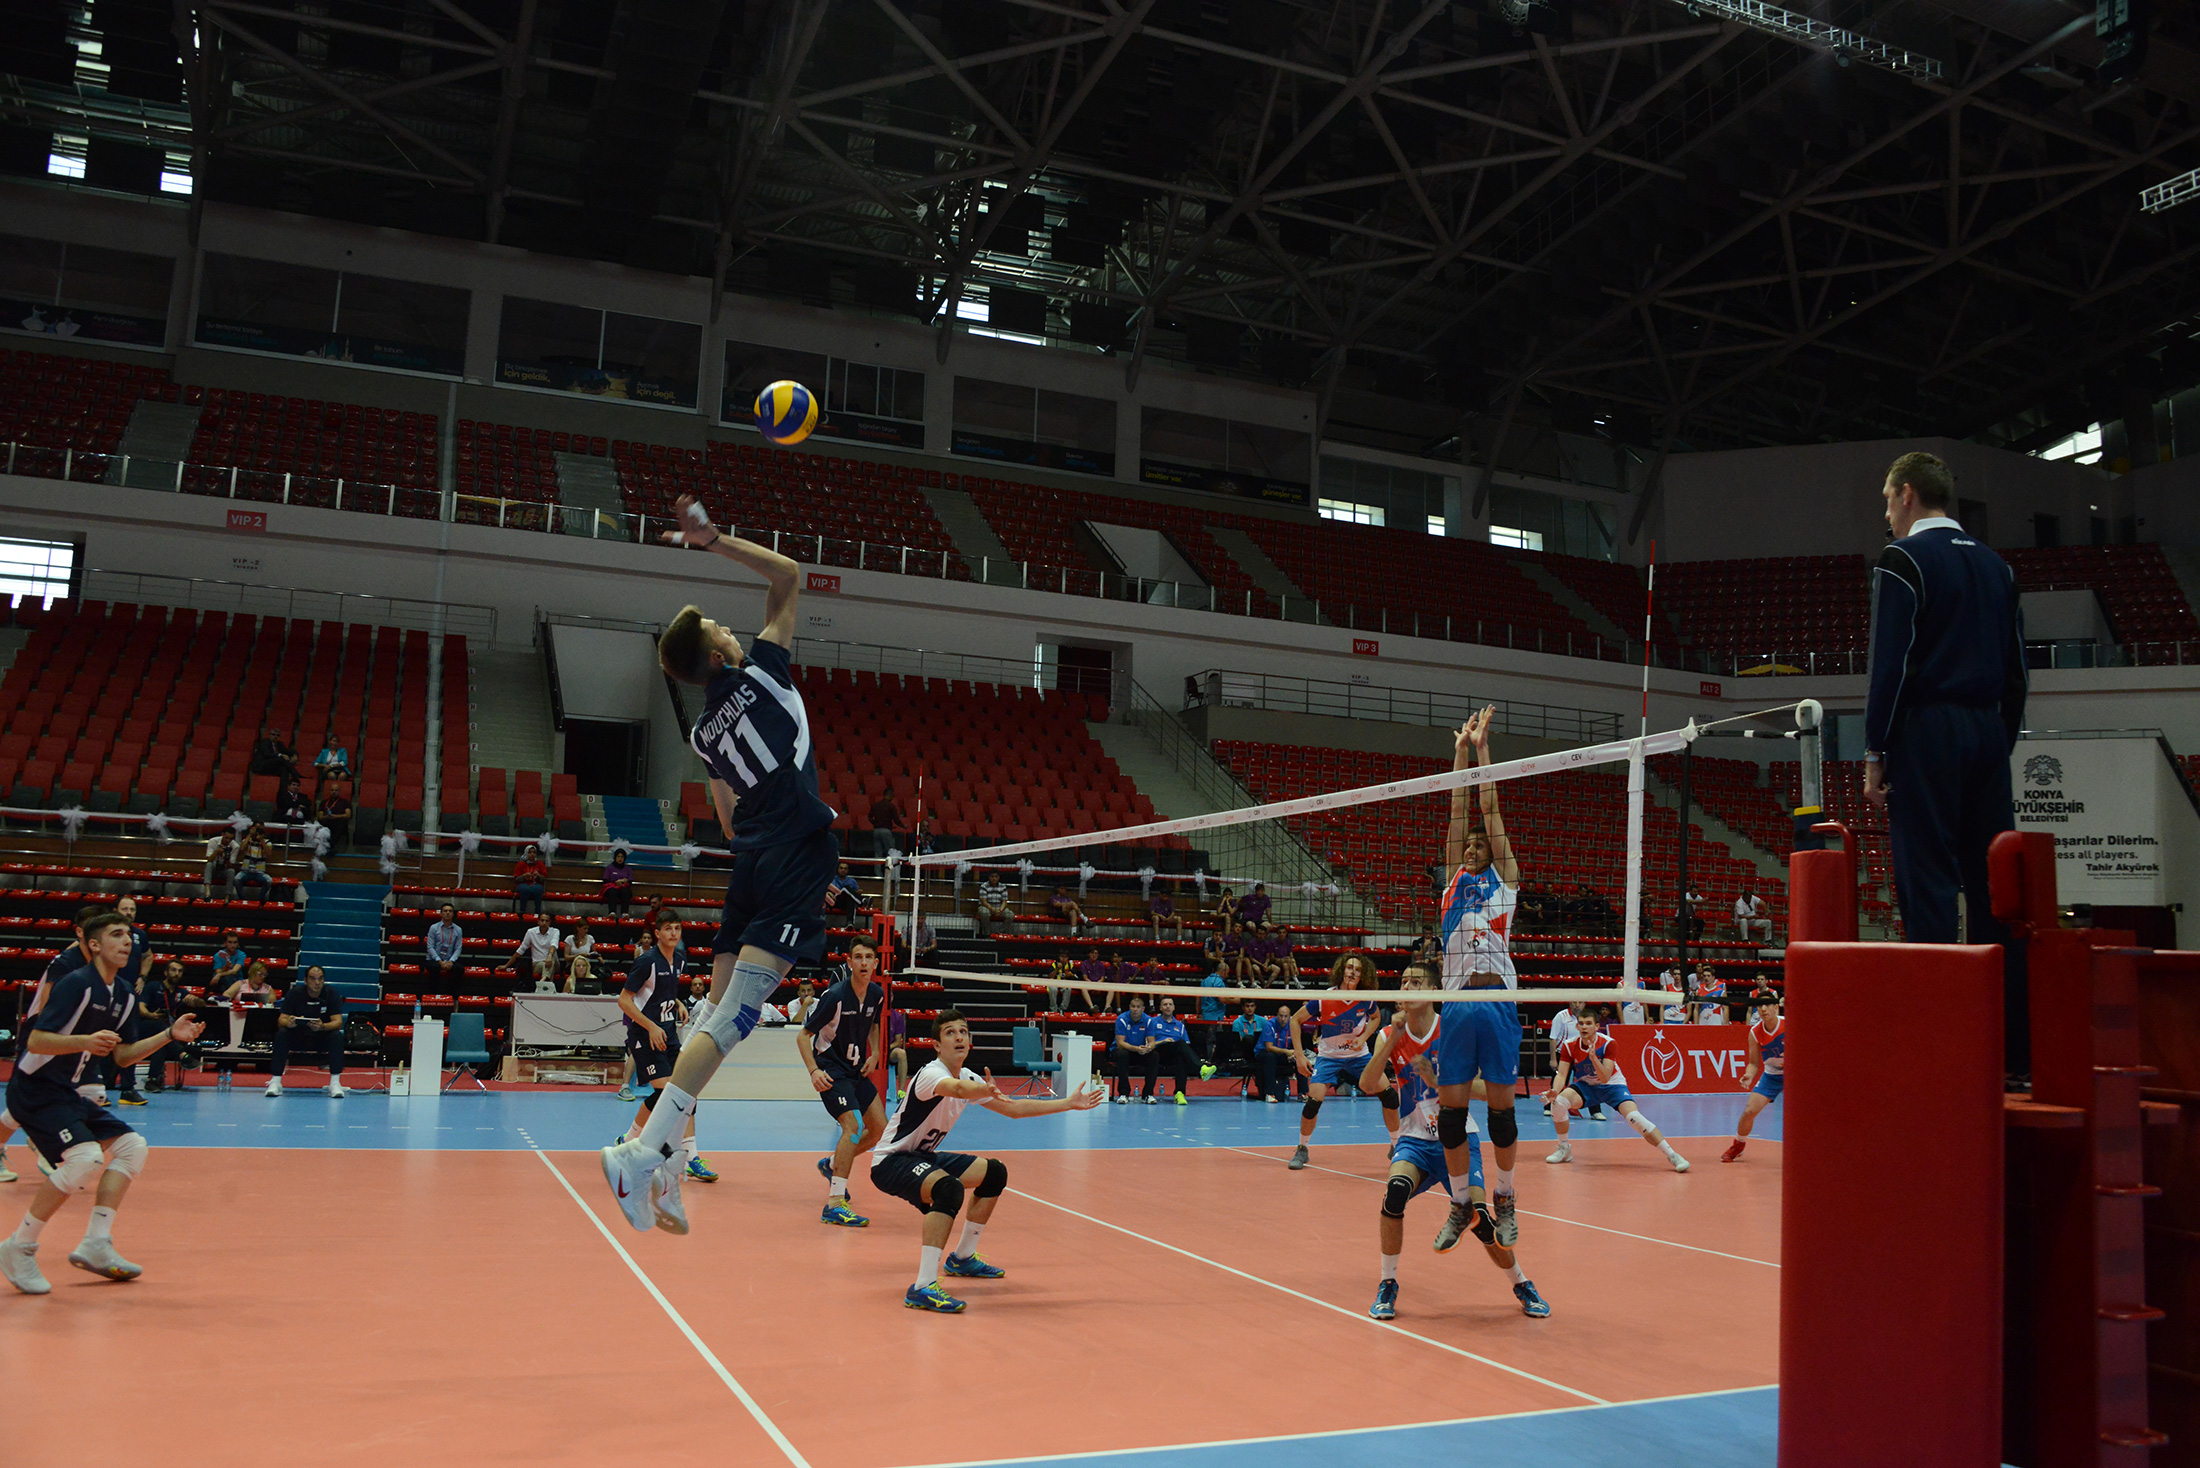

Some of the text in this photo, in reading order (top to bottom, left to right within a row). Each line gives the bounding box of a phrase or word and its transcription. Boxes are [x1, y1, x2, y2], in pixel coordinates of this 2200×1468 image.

[231, 514, 263, 527] VIP 2
[811, 577, 837, 590] VIP 1
[1356, 642, 1377, 653] VIP 3
[1702, 684, 1720, 695] ALT 2
[699, 683, 758, 748] MOUCHLIAS
[717, 712, 780, 789] 11
[1571, 753, 1583, 762] CEV
[1471, 771, 1481, 779] CEV
[2024, 790, 2064, 799] KONYA
[2013, 799, 2085, 815] ÜYÜKŞEHİR
[2020, 814, 2069, 823] BELEDİYESİ
[2054, 834, 2159, 848] aşarılar Dilerim.
[2078, 850, 2092, 859] all
[2094, 850, 2139, 861] players.
[2086, 863, 2160, 873] Tahir Akyürek
[1463, 884, 1484, 914] 2
[779, 923, 801, 948] 11
[660, 1000, 676, 1022] 12
[1341, 1019, 1356, 1034] 3
[846, 1043, 860, 1067] 4
[71, 1050, 92, 1084] 6
[646, 1063, 657, 1076] 12
[1687, 1049, 1746, 1079] TVF
[838, 1096, 848, 1107] 4
[58, 1128, 74, 1144] 6
[912, 1161, 932, 1177] 20
